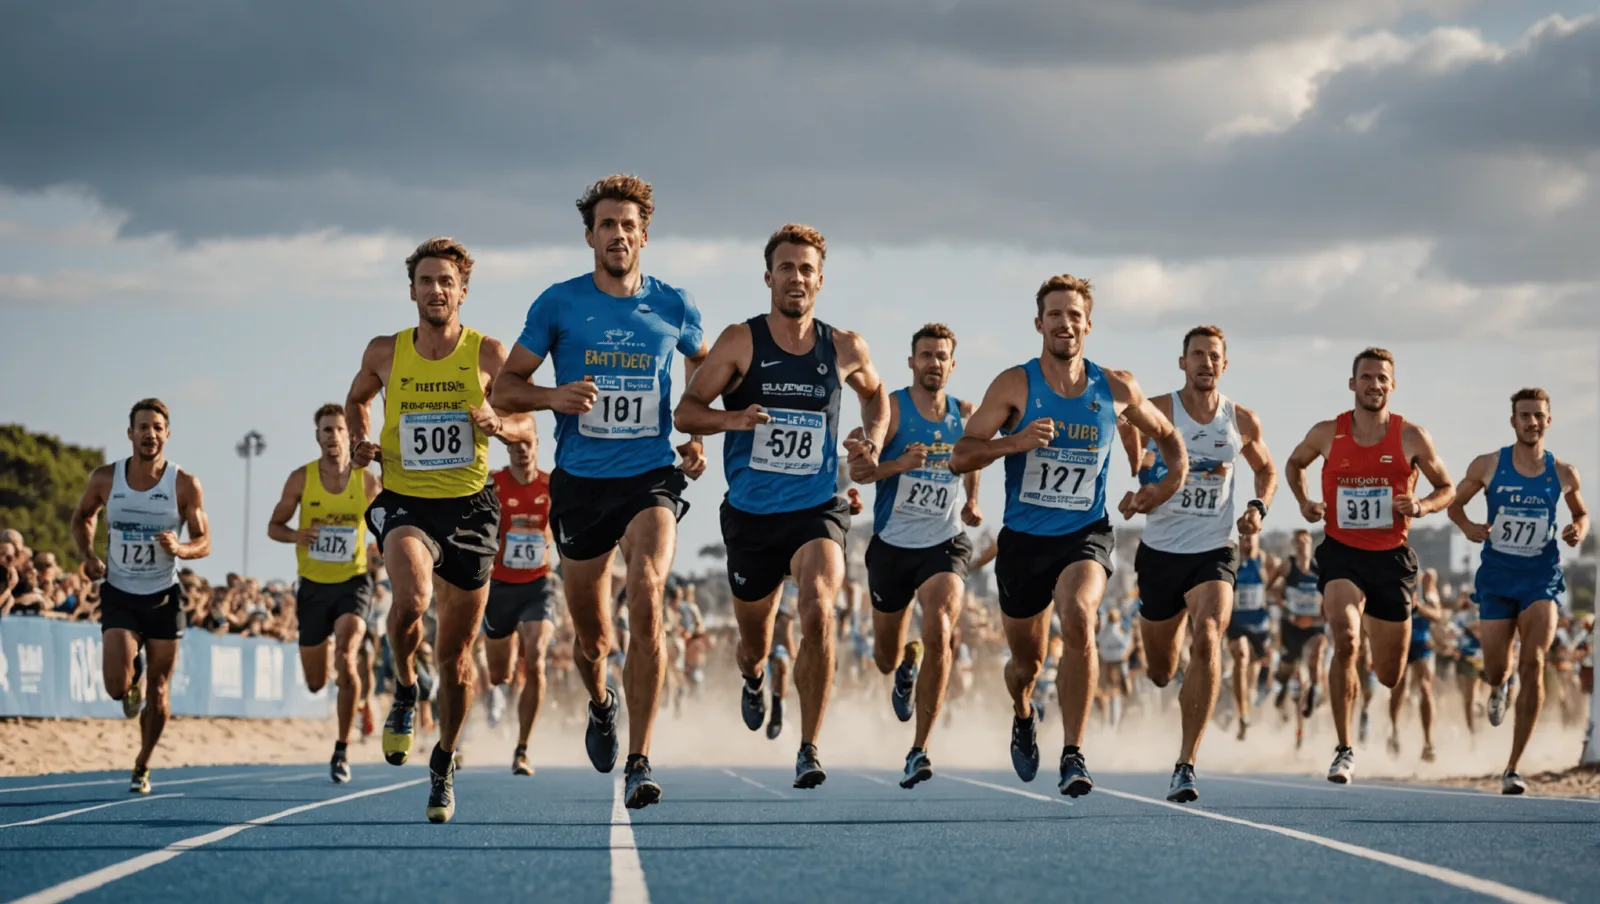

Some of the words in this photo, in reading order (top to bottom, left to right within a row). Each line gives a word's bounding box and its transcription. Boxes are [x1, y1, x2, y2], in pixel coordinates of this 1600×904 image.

[602, 395, 644, 424] 181
[413, 425, 462, 455] 508
[1038, 462, 1087, 495] 127
